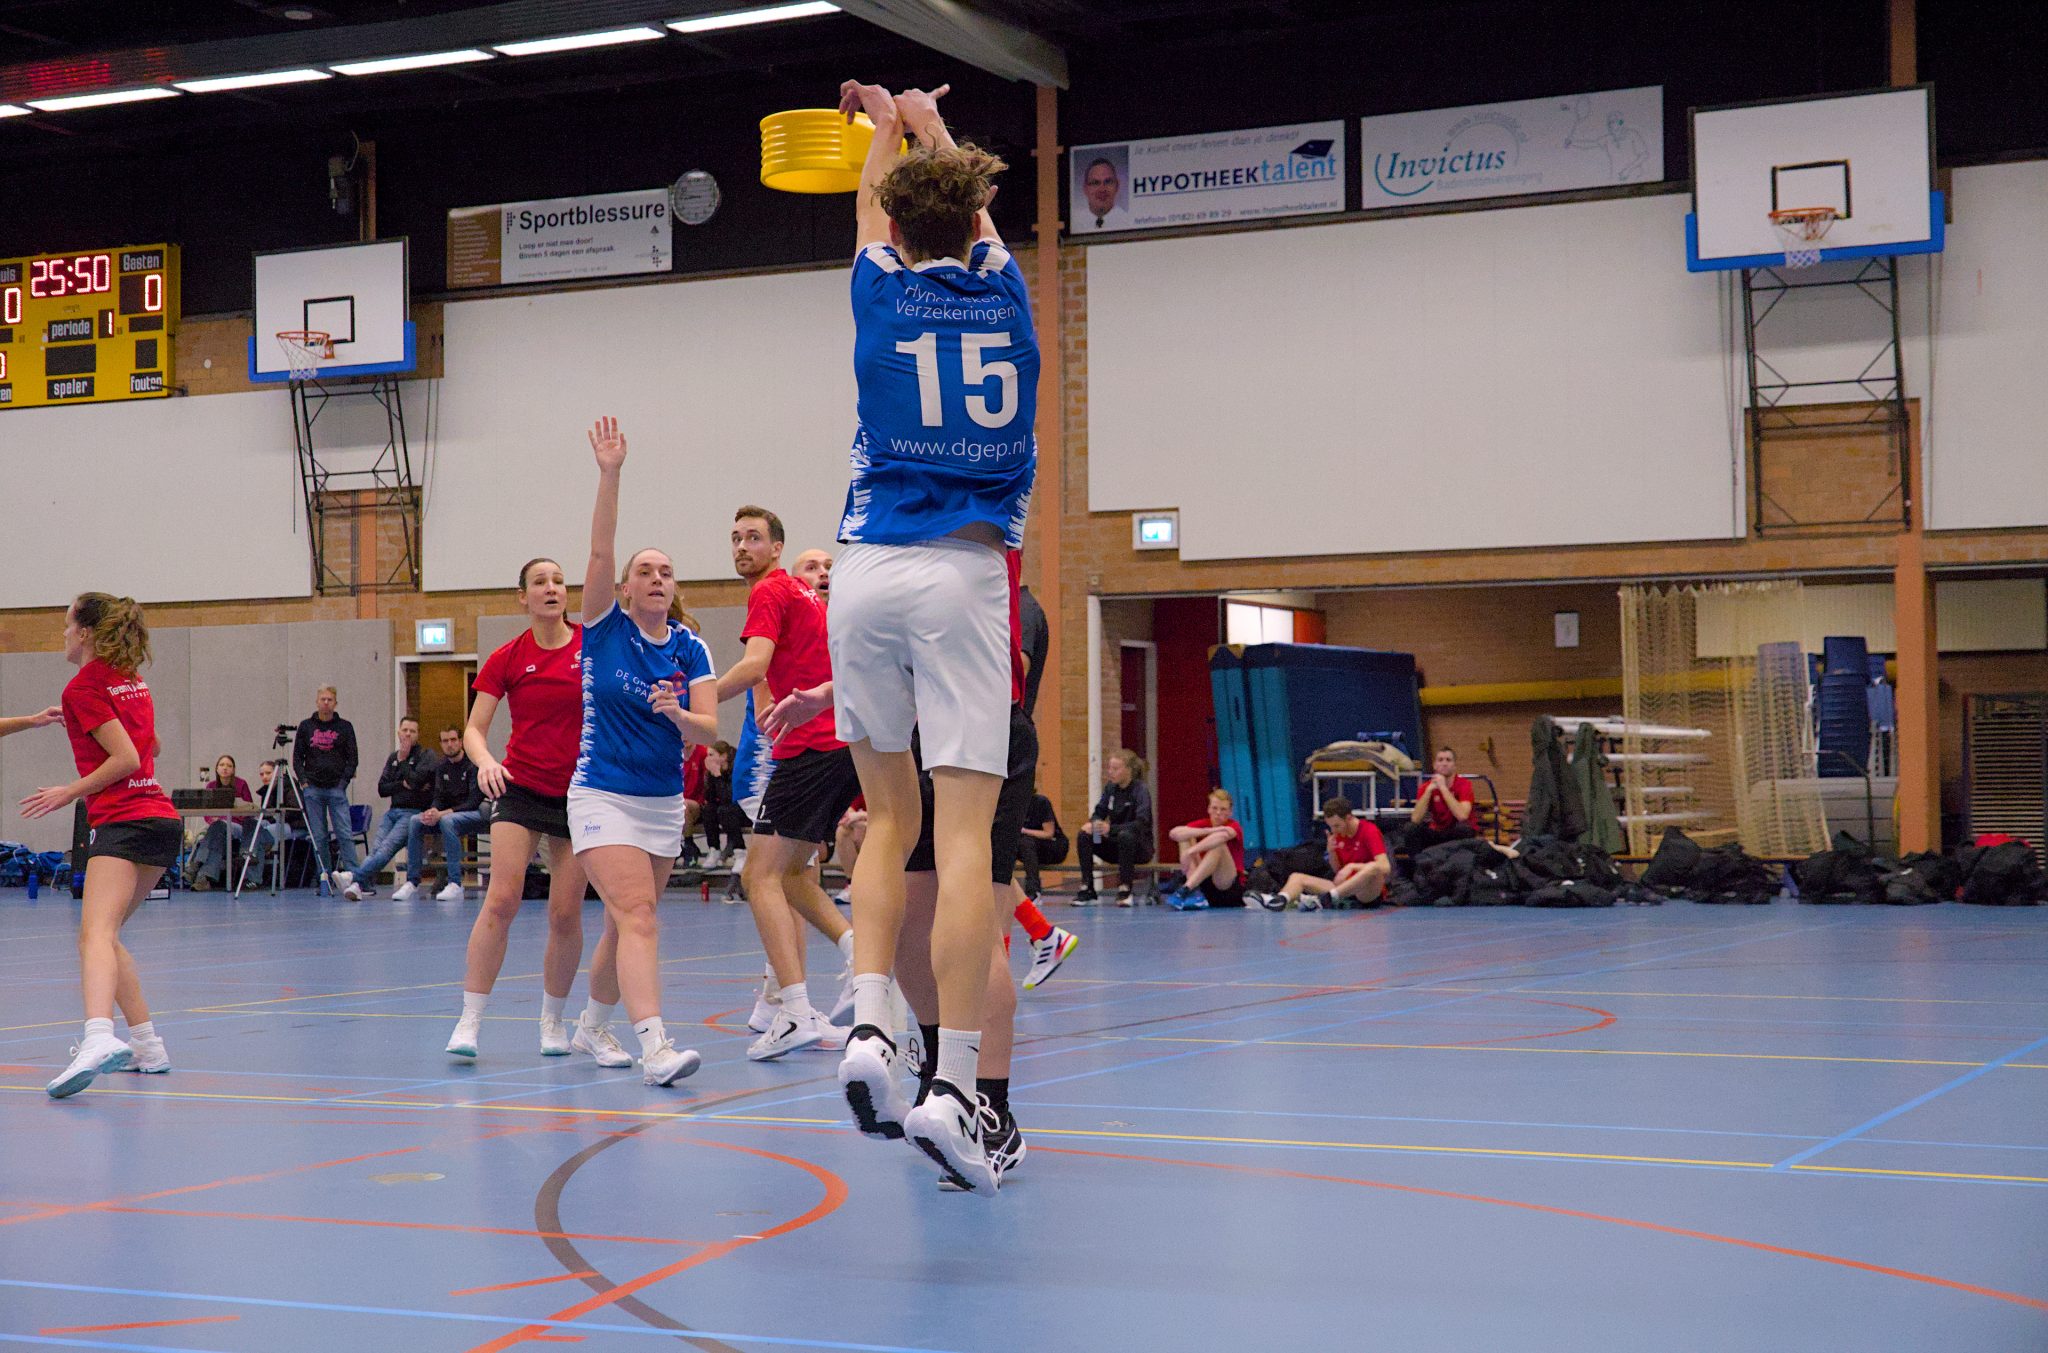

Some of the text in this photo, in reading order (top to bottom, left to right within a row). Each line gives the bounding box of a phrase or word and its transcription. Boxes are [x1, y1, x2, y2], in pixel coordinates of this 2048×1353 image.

[1387, 146, 1506, 179] Invictus
[519, 202, 665, 233] Sportblessure
[31, 254, 110, 298] 25:50
[123, 253, 160, 272] Gasten
[4, 287, 22, 324] 0
[145, 273, 162, 312] 0
[108, 311, 113, 335] 1
[896, 298, 1016, 325] Verzekeringen
[51, 320, 91, 340] periode
[53, 378, 88, 398] speler
[130, 375, 162, 392] fouten
[895, 332, 1019, 428] 15
[890, 435, 1026, 463] www.dgep.nl
